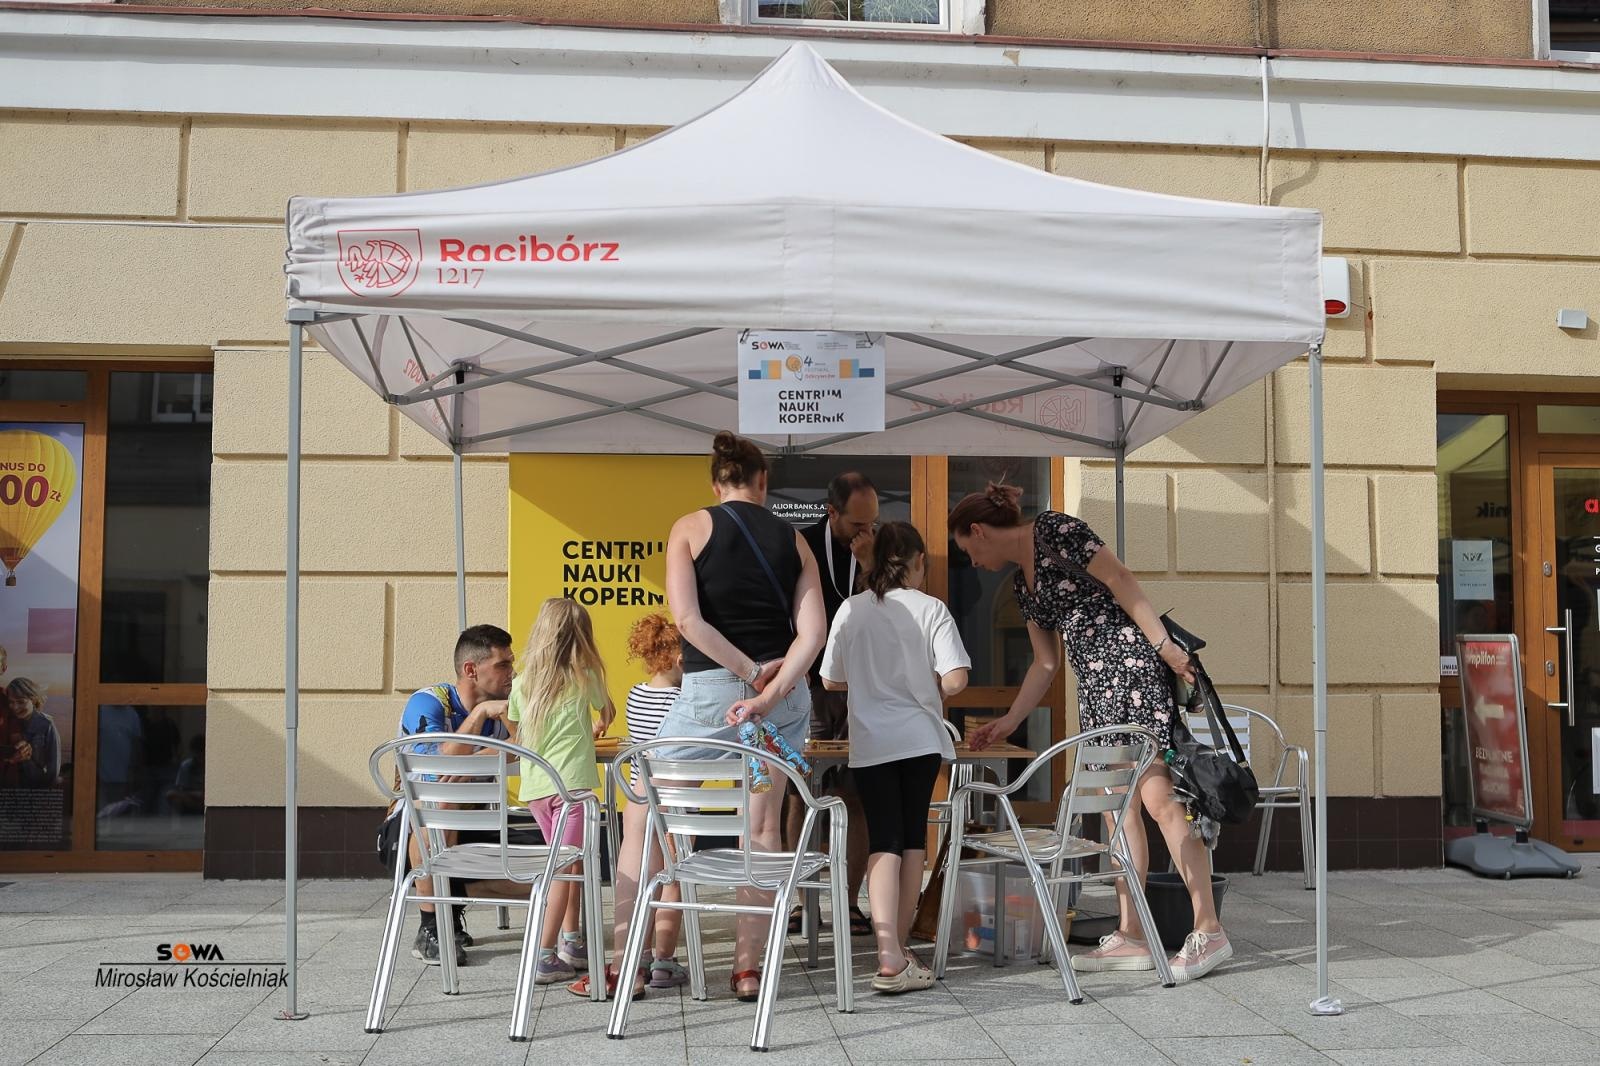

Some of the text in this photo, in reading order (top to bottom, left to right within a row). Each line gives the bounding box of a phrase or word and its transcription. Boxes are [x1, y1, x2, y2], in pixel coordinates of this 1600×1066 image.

[439, 235, 620, 262] Racibórz
[436, 267, 485, 289] 1217
[751, 341, 785, 350] SOWA
[778, 402, 819, 412] NAUKI
[779, 412, 845, 424] KOPERNIK
[28, 463, 46, 472] DO
[563, 564, 640, 582] NAUKI
